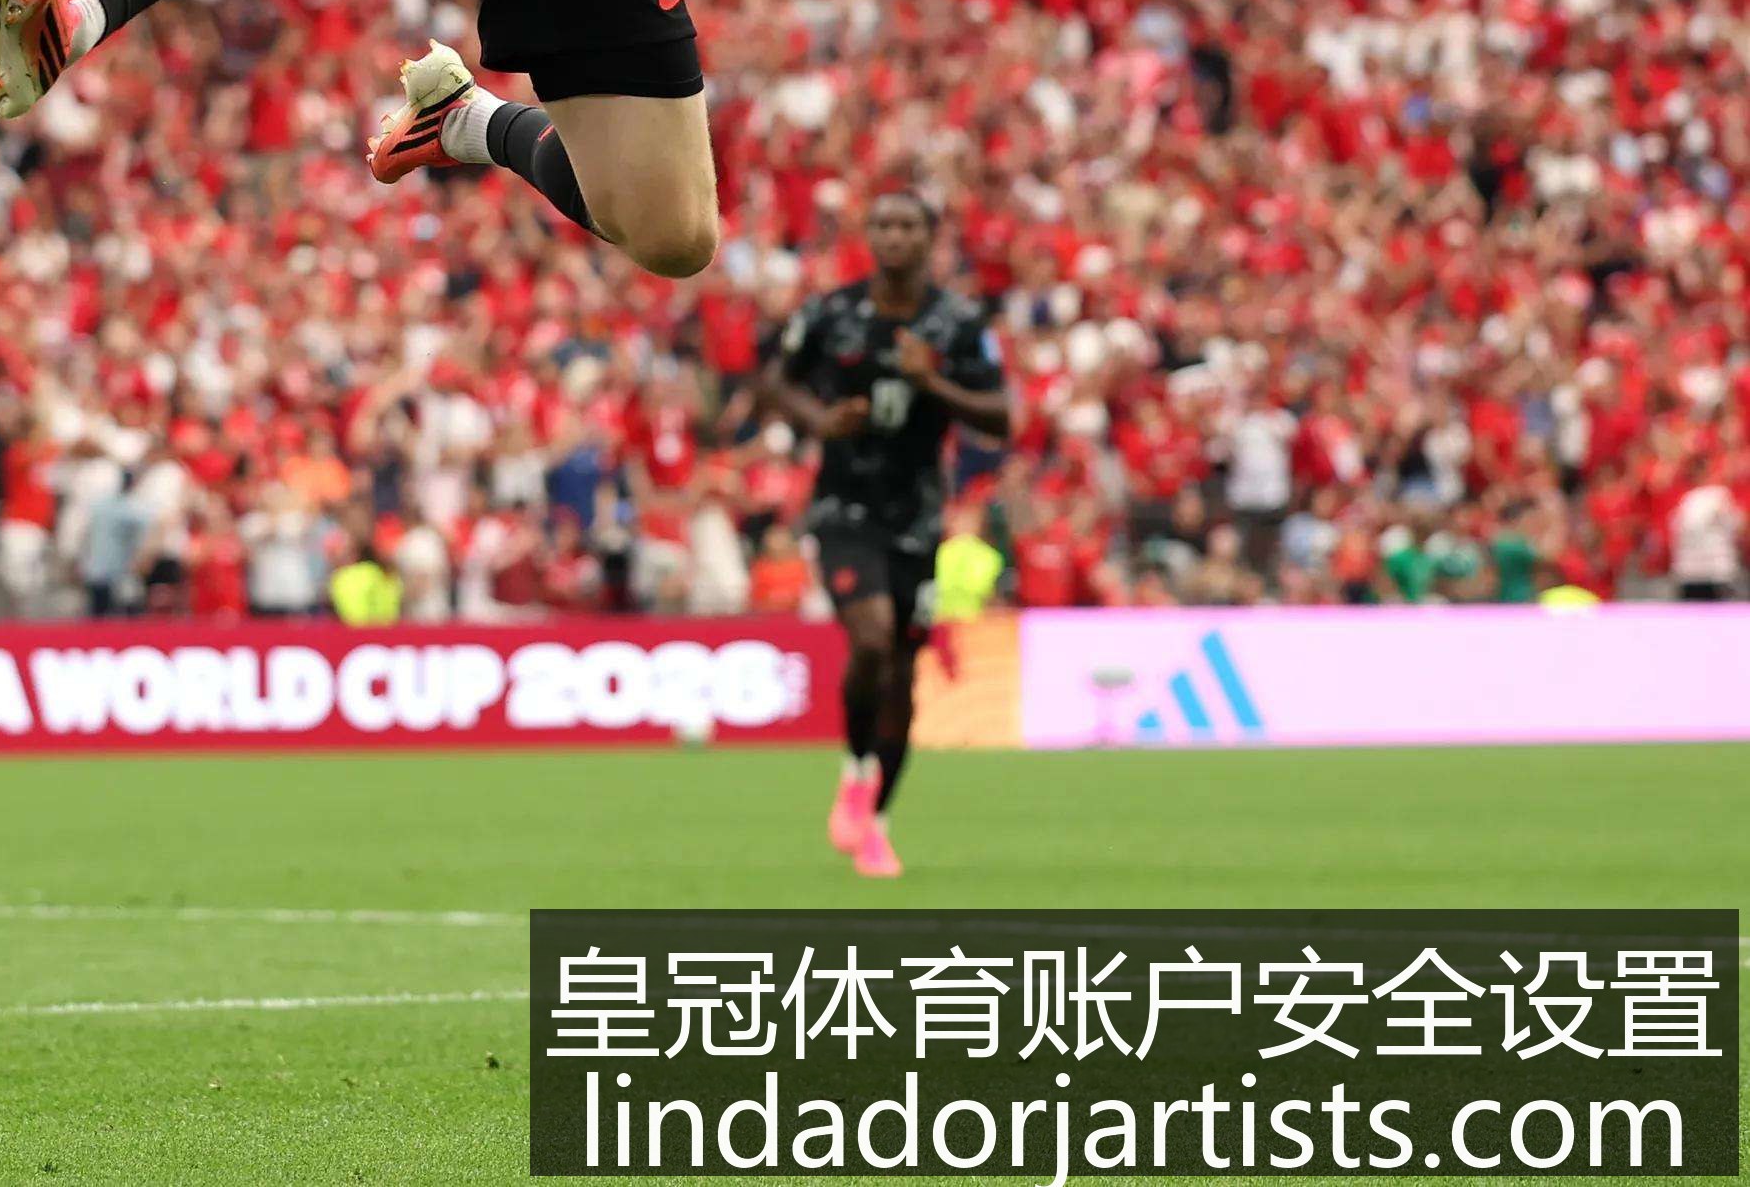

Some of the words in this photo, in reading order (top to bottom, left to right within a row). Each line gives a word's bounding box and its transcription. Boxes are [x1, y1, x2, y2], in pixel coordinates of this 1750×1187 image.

[30, 646, 334, 734] WORLD
[337, 643, 507, 731] CUP
[506, 640, 788, 730] 2026
